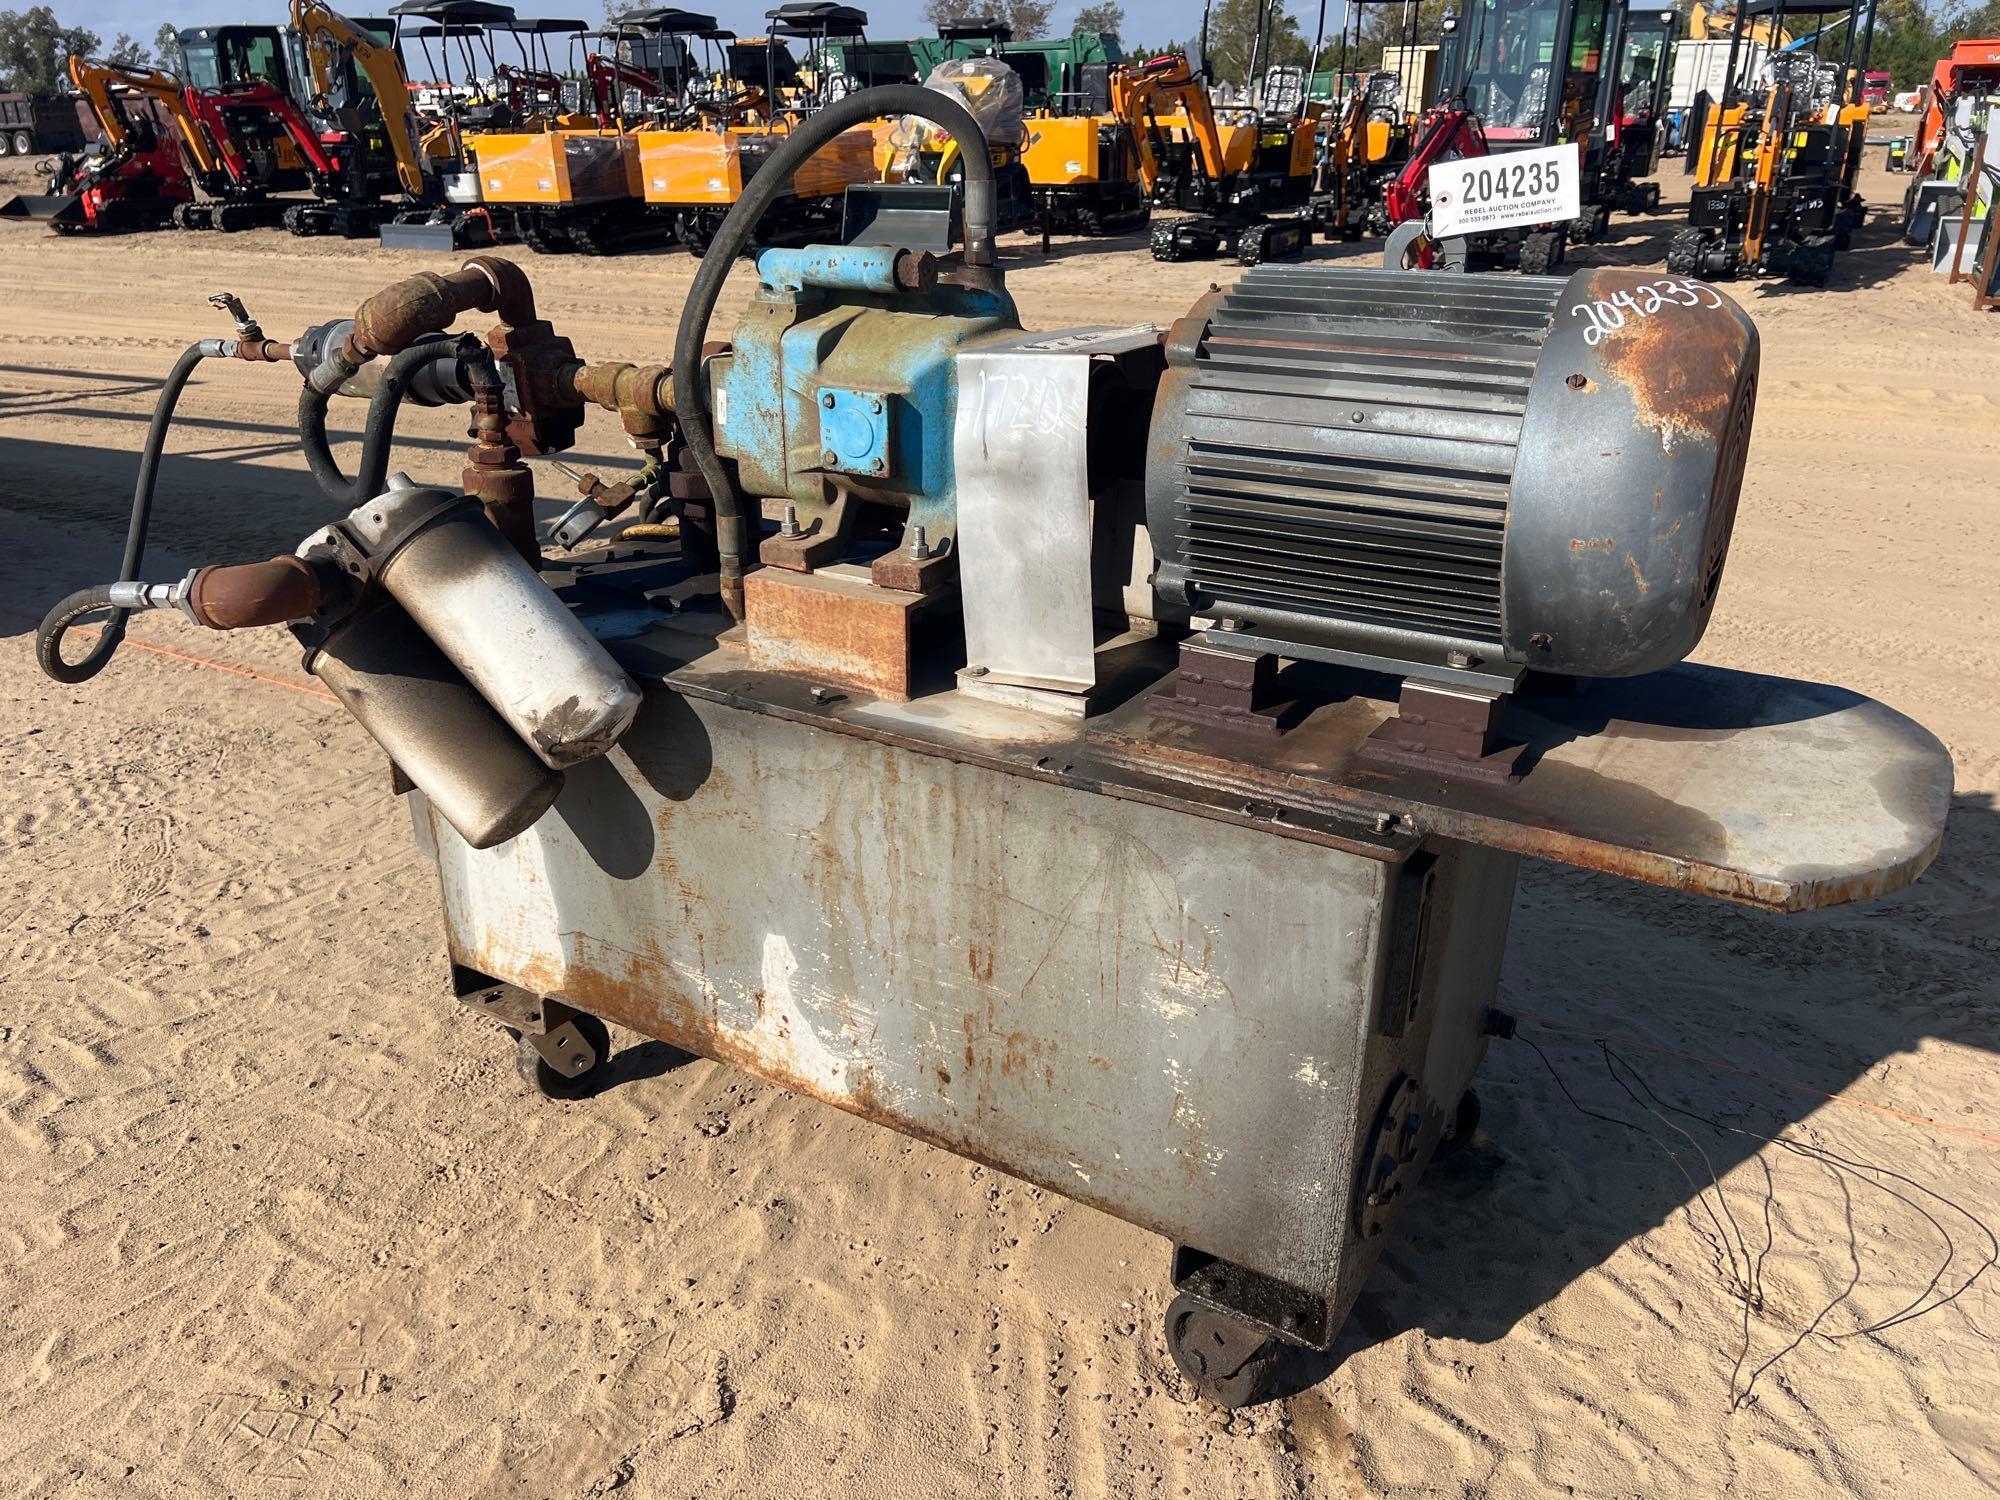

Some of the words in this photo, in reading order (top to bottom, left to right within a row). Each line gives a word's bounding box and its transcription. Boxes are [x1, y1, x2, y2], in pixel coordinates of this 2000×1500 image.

[1462, 160, 1560, 204] 204235
[1464, 206, 1487, 215] REBEL
[1488, 203, 1519, 213] AUCTION
[1520, 198, 1556, 209] COMPANY
[1500, 206, 1563, 219] www.rebelauction.net
[1571, 278, 1723, 345] 204235
